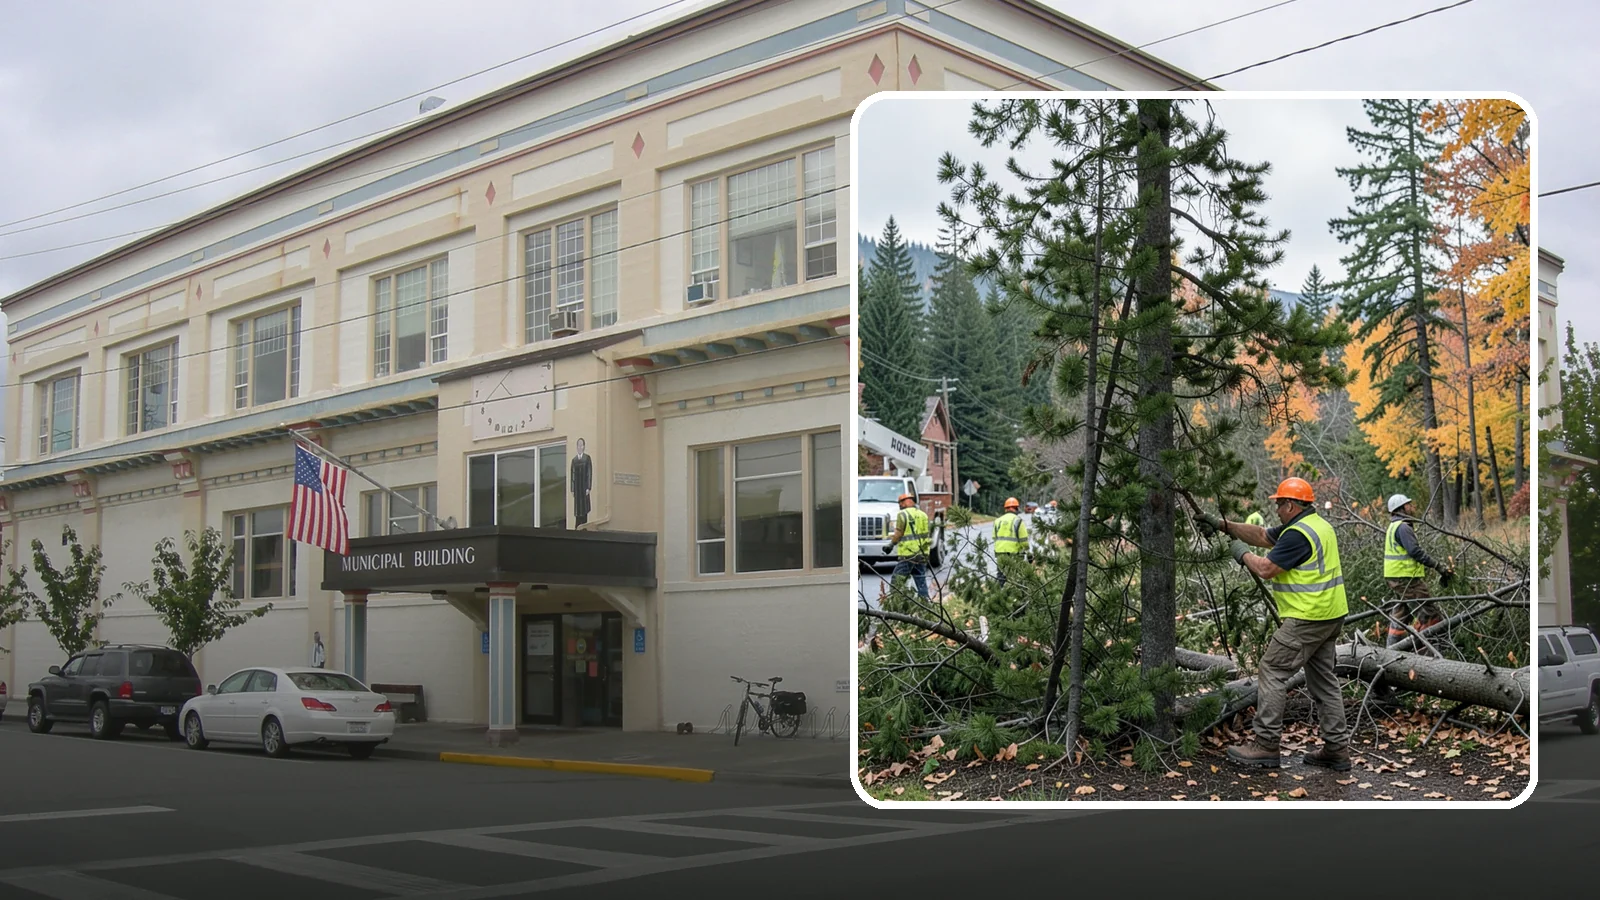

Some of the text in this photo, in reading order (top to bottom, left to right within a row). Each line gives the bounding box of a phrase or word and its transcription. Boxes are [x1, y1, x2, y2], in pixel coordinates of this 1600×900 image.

[476, 390, 479, 398] 7
[536, 402, 540, 410] 4
[481, 407, 485, 415] 8
[488, 418, 492, 426] 9
[529, 414, 533, 422] 3
[495, 423, 500, 432] 10
[342, 546, 475, 572] MUNICIPAL BUILDING
